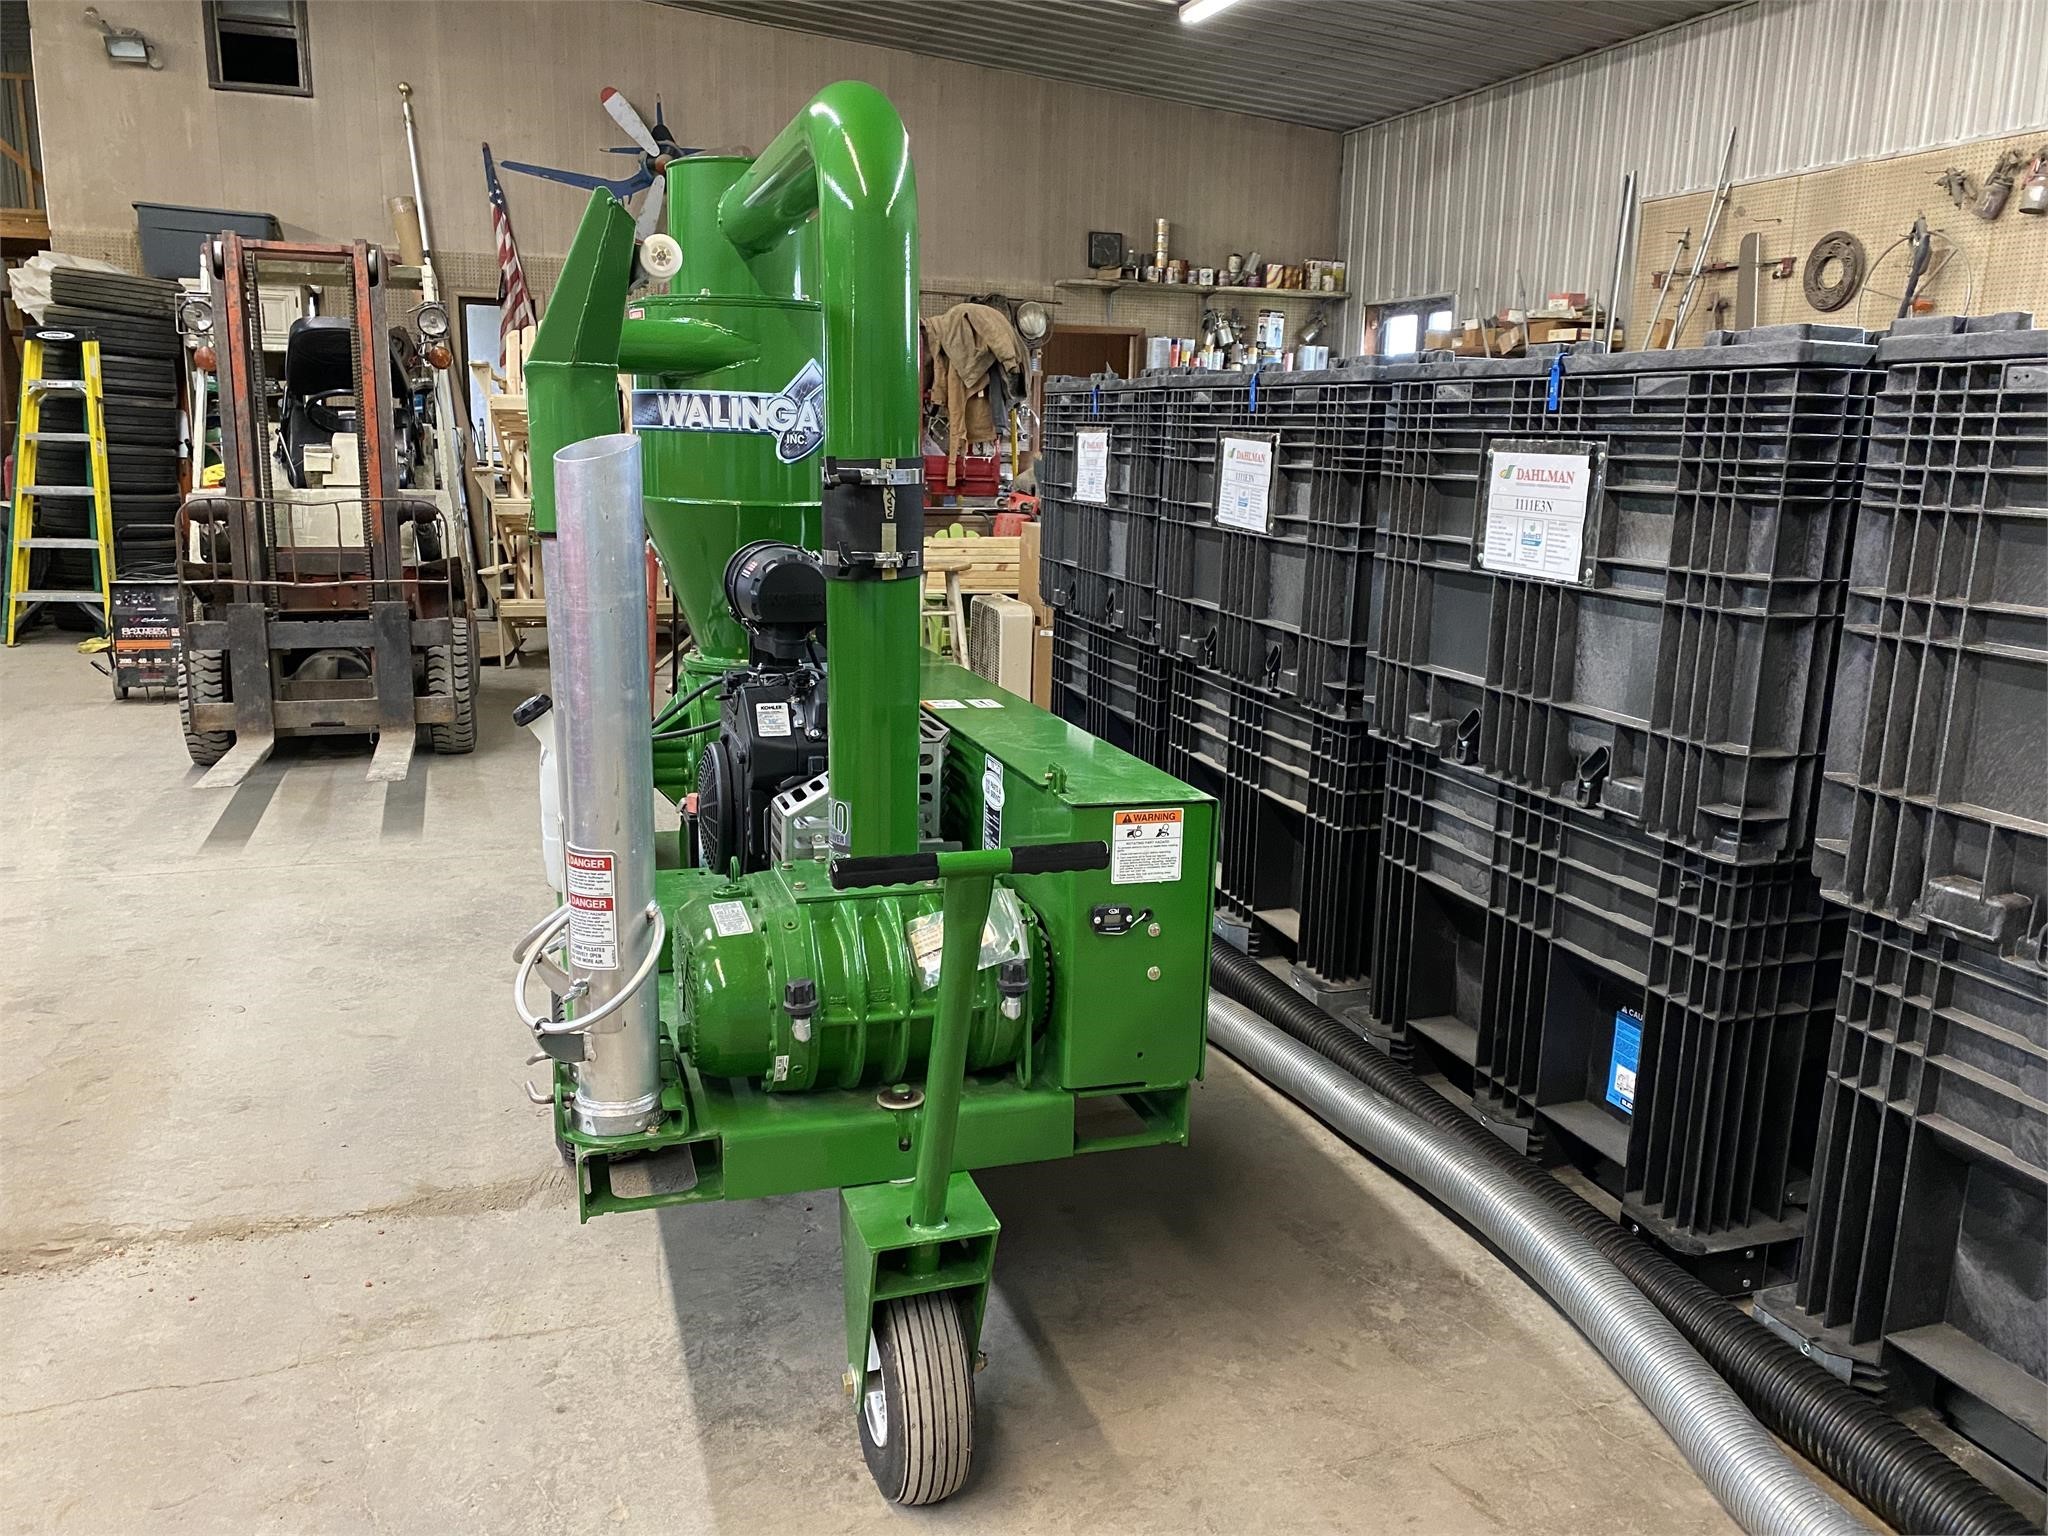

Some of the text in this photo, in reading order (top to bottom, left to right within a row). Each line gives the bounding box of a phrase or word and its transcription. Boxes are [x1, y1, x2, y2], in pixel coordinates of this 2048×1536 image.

[656, 392, 820, 433] WALINGA
[786, 432, 808, 445] INC.
[1516, 468, 1575, 485] DAHLMAN
[1515, 498, 1555, 513] 1111E3N
[1133, 812, 1176, 822] WARNING
[569, 856, 605, 868] DANGER
[571, 897, 607, 909] DANGER
